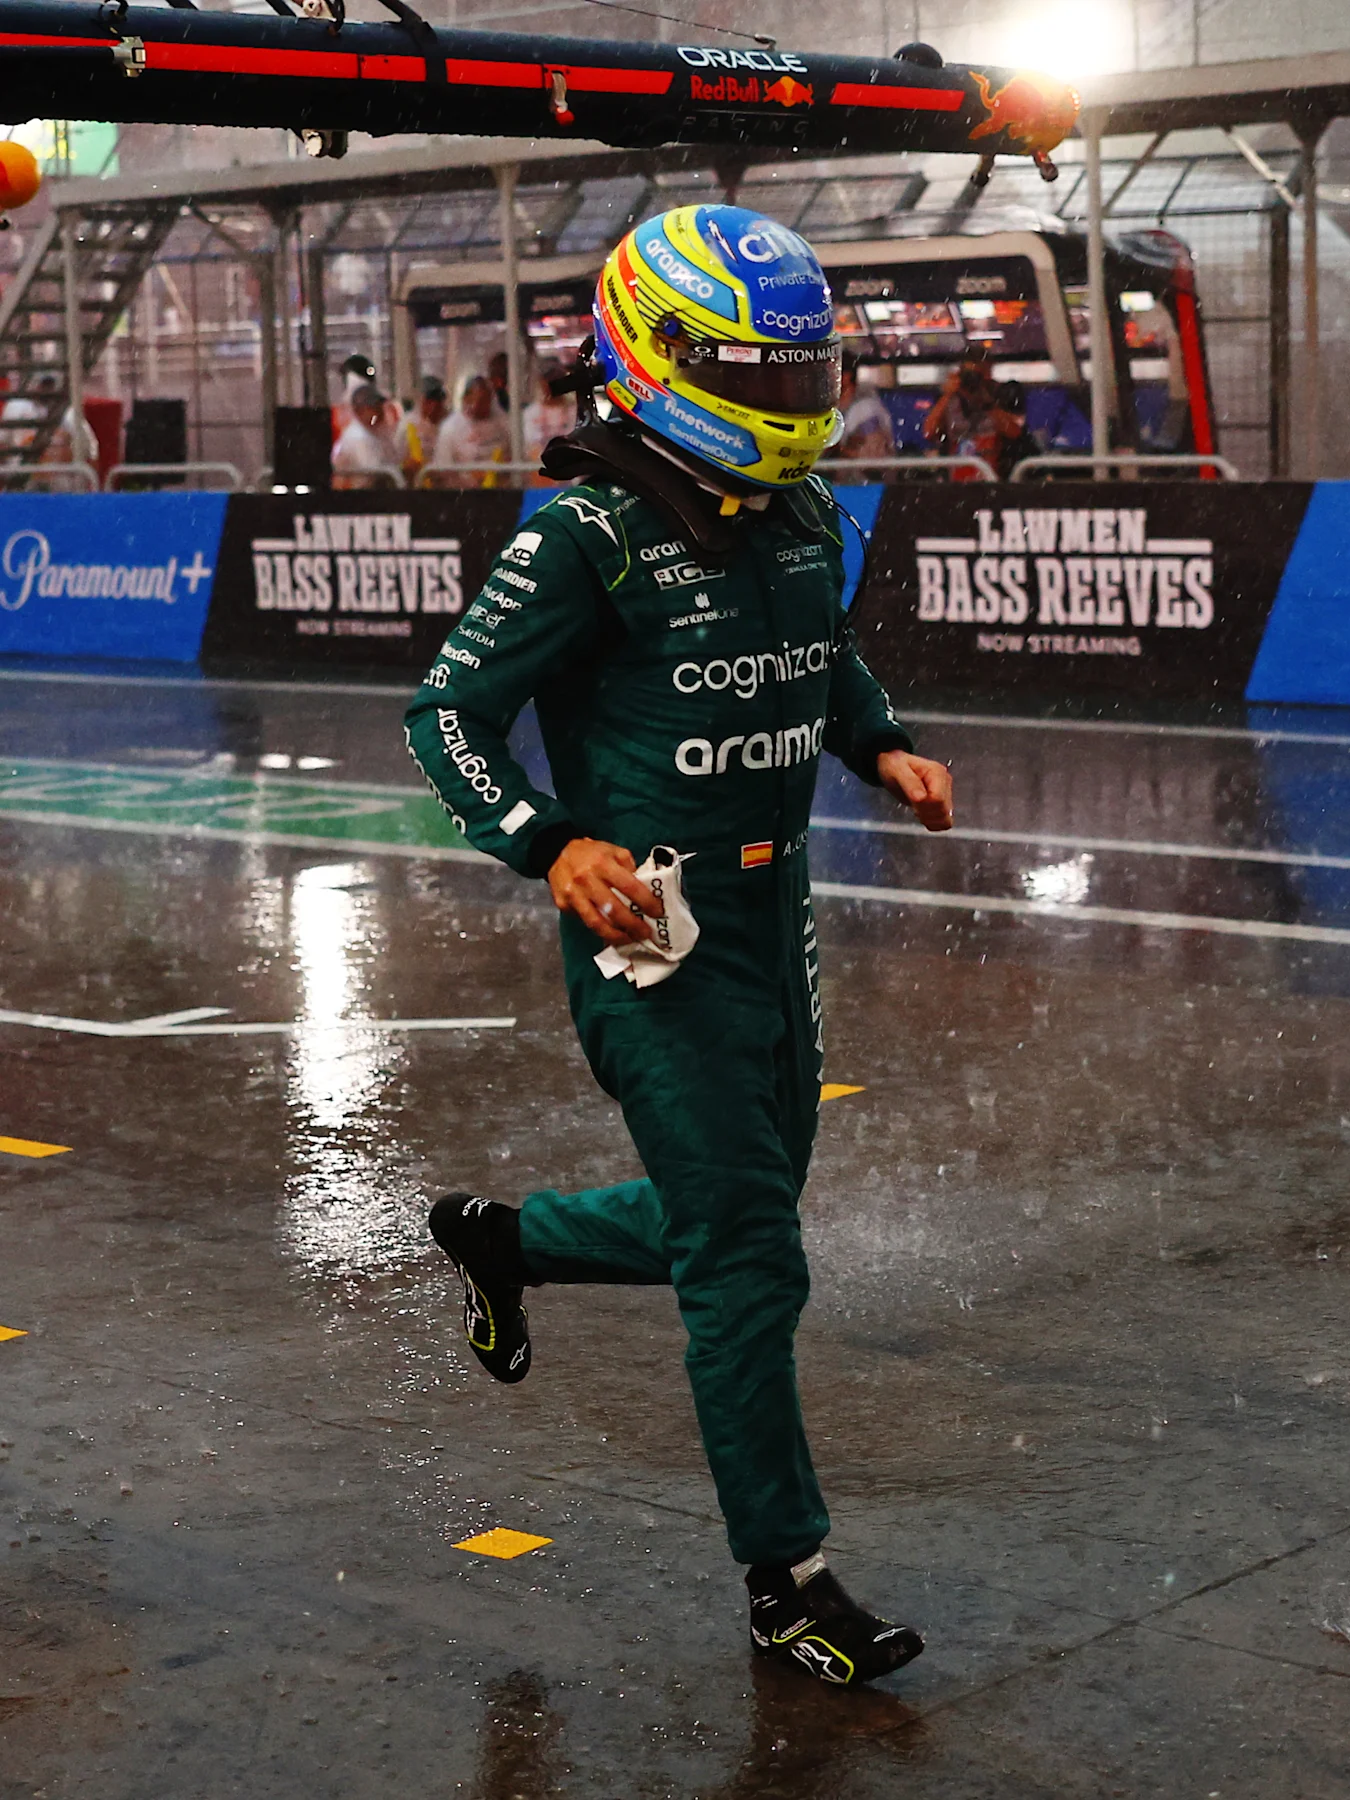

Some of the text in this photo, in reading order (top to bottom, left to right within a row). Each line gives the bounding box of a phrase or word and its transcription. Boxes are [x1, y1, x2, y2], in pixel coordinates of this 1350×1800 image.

[677, 46, 808, 73] ORACLE
[607, 275, 638, 343] BOMBARDIER
[767, 349, 814, 363] ASTON
[628, 378, 651, 400] BELL
[664, 398, 745, 450] finetwork
[293, 513, 413, 552] LAWMEN
[977, 508, 1148, 554] LAWMEN
[0, 529, 213, 611] Paramount+
[252, 553, 465, 614] BASS REEVES
[917, 554, 1214, 630] BASS REEVES
[333, 620, 412, 637] STREAMING
[457, 625, 496, 649] SAUDIA
[977, 633, 1142, 656] NOW STREAMING
